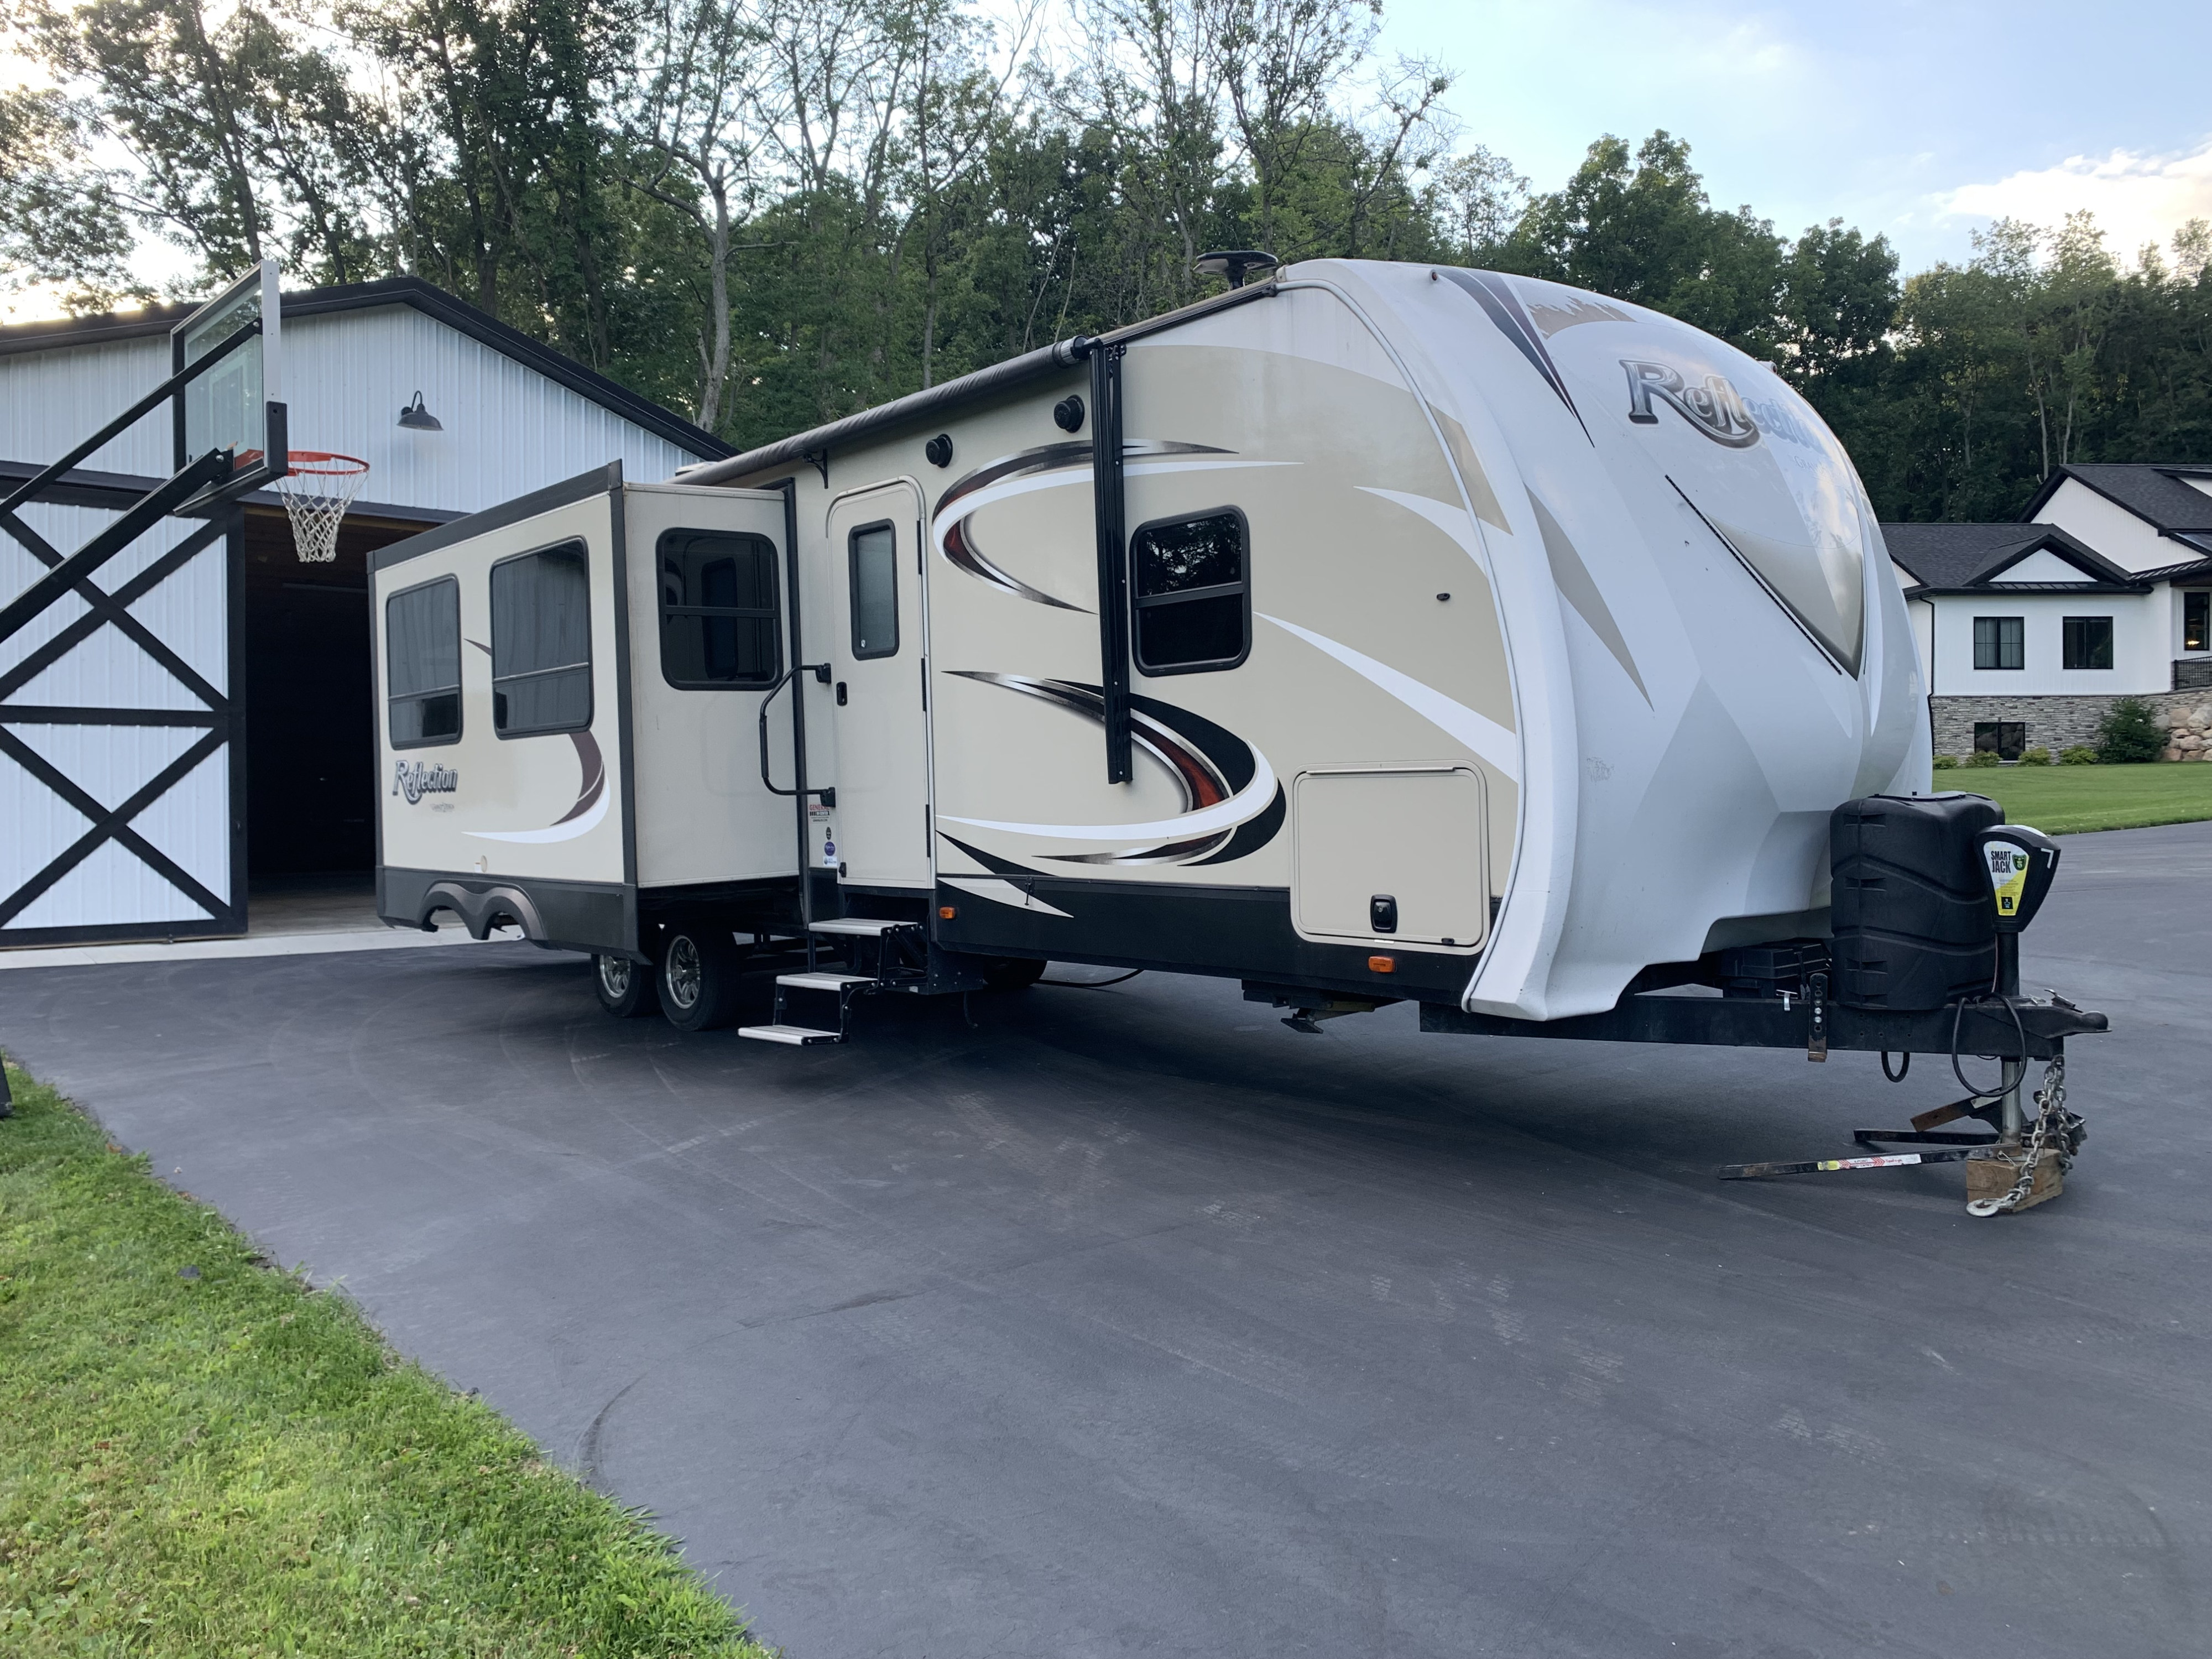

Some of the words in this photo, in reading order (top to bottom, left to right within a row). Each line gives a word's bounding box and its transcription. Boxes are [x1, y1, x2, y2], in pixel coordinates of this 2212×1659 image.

[1619, 358, 1829, 449] Reflectio
[392, 759, 458, 805] Reflection
[1991, 851, 2011, 860] SMART
[1992, 861, 2011, 873] JACK
